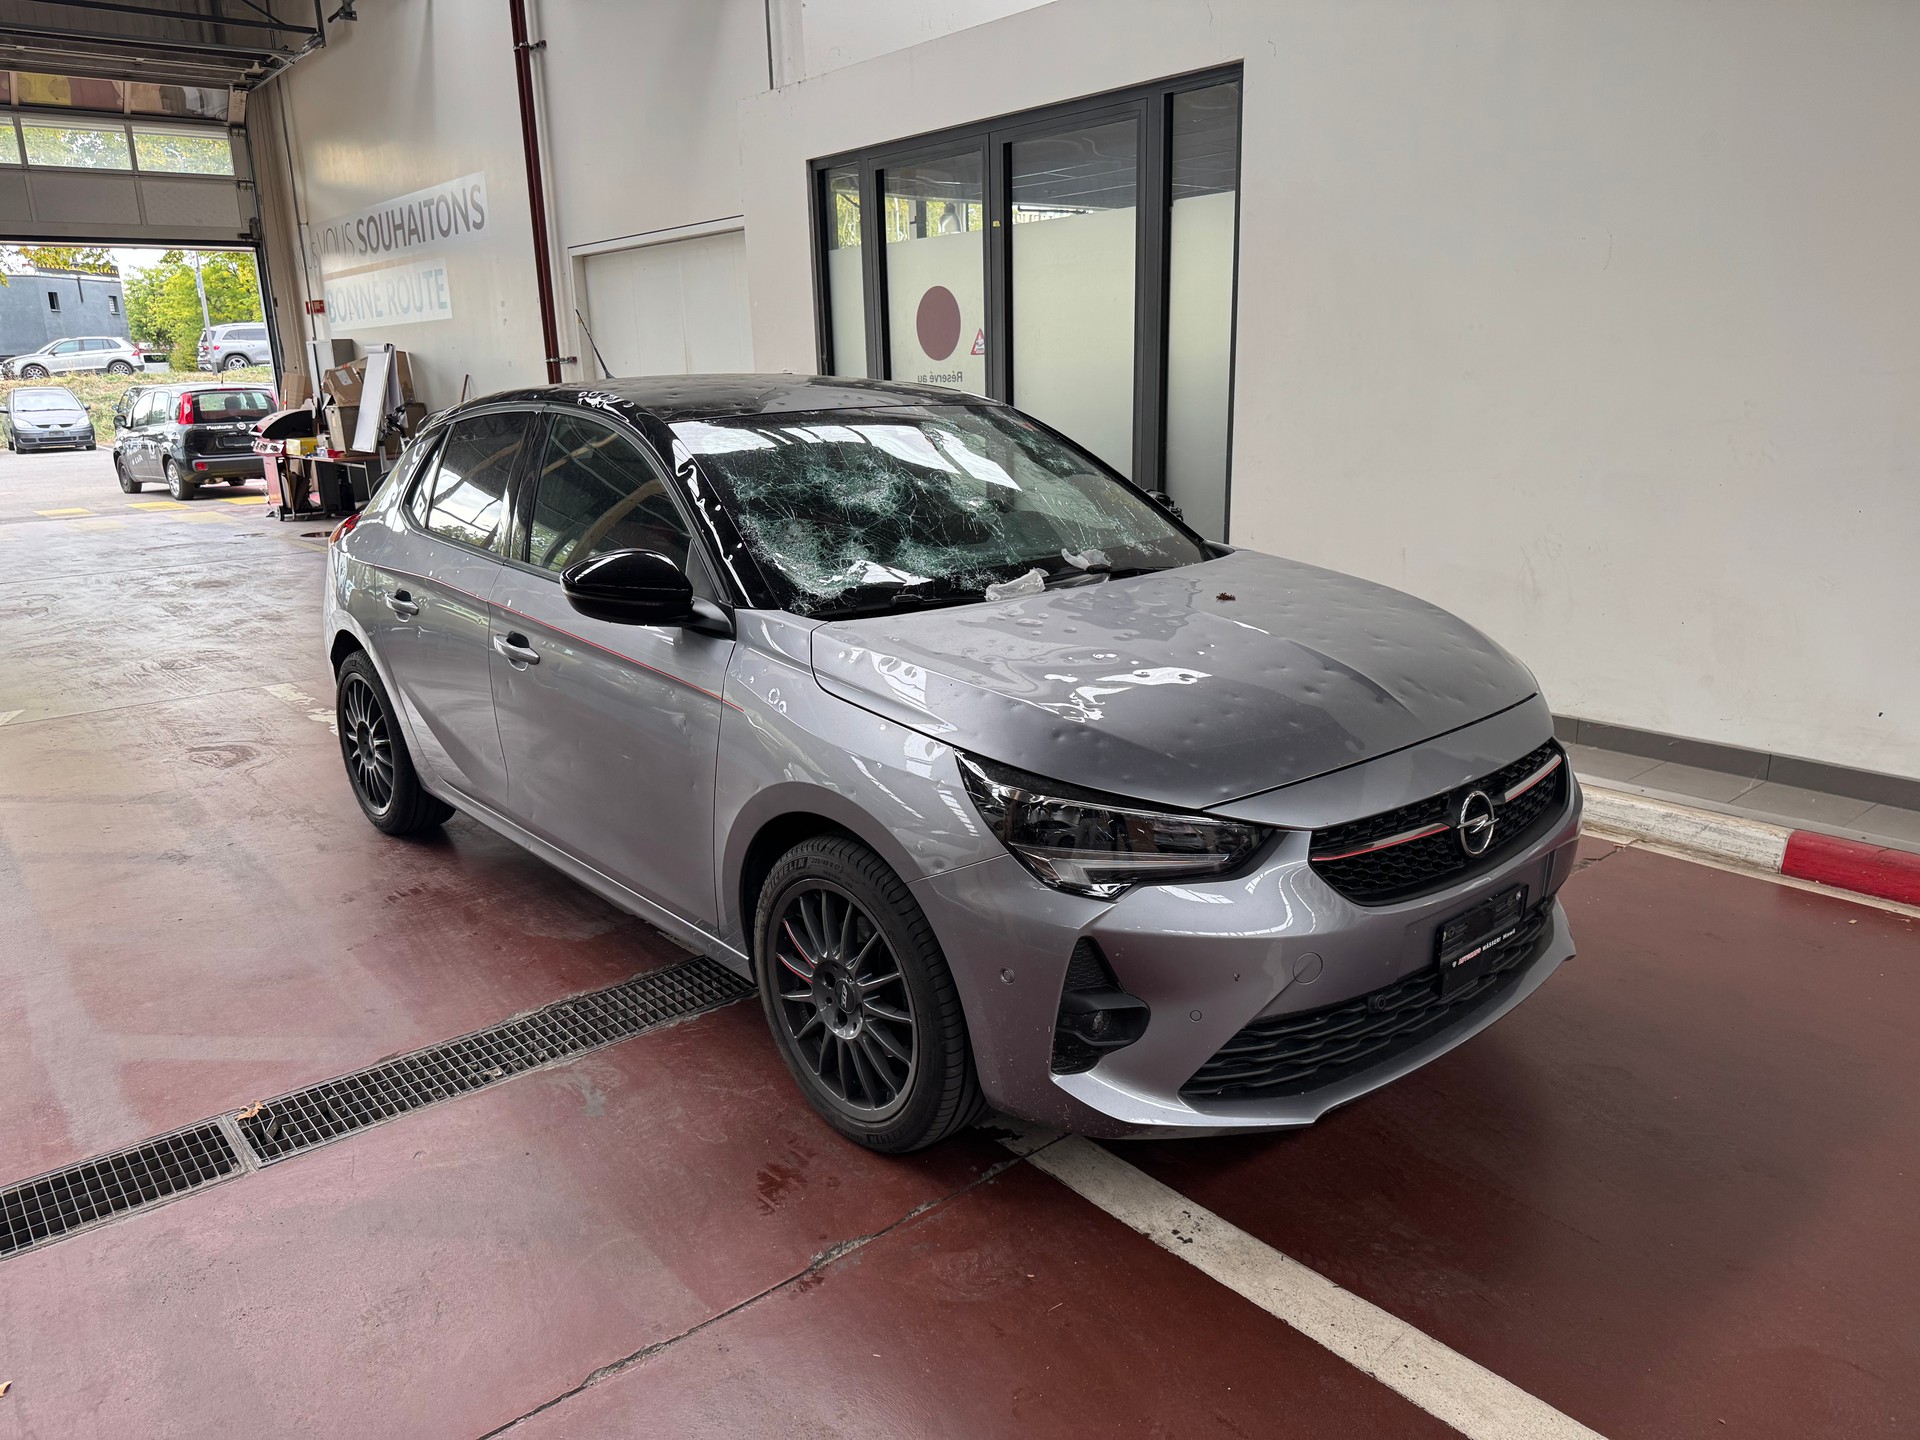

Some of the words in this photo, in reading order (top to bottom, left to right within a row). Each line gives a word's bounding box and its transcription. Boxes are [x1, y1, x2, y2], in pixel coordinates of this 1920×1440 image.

[317, 222, 355, 258] VOUS
[356, 184, 485, 256] SOUHAITONS
[327, 280, 384, 323] BONNE
[386, 268, 448, 316] ROUTE
[765, 856, 809, 895] MICHELIN
